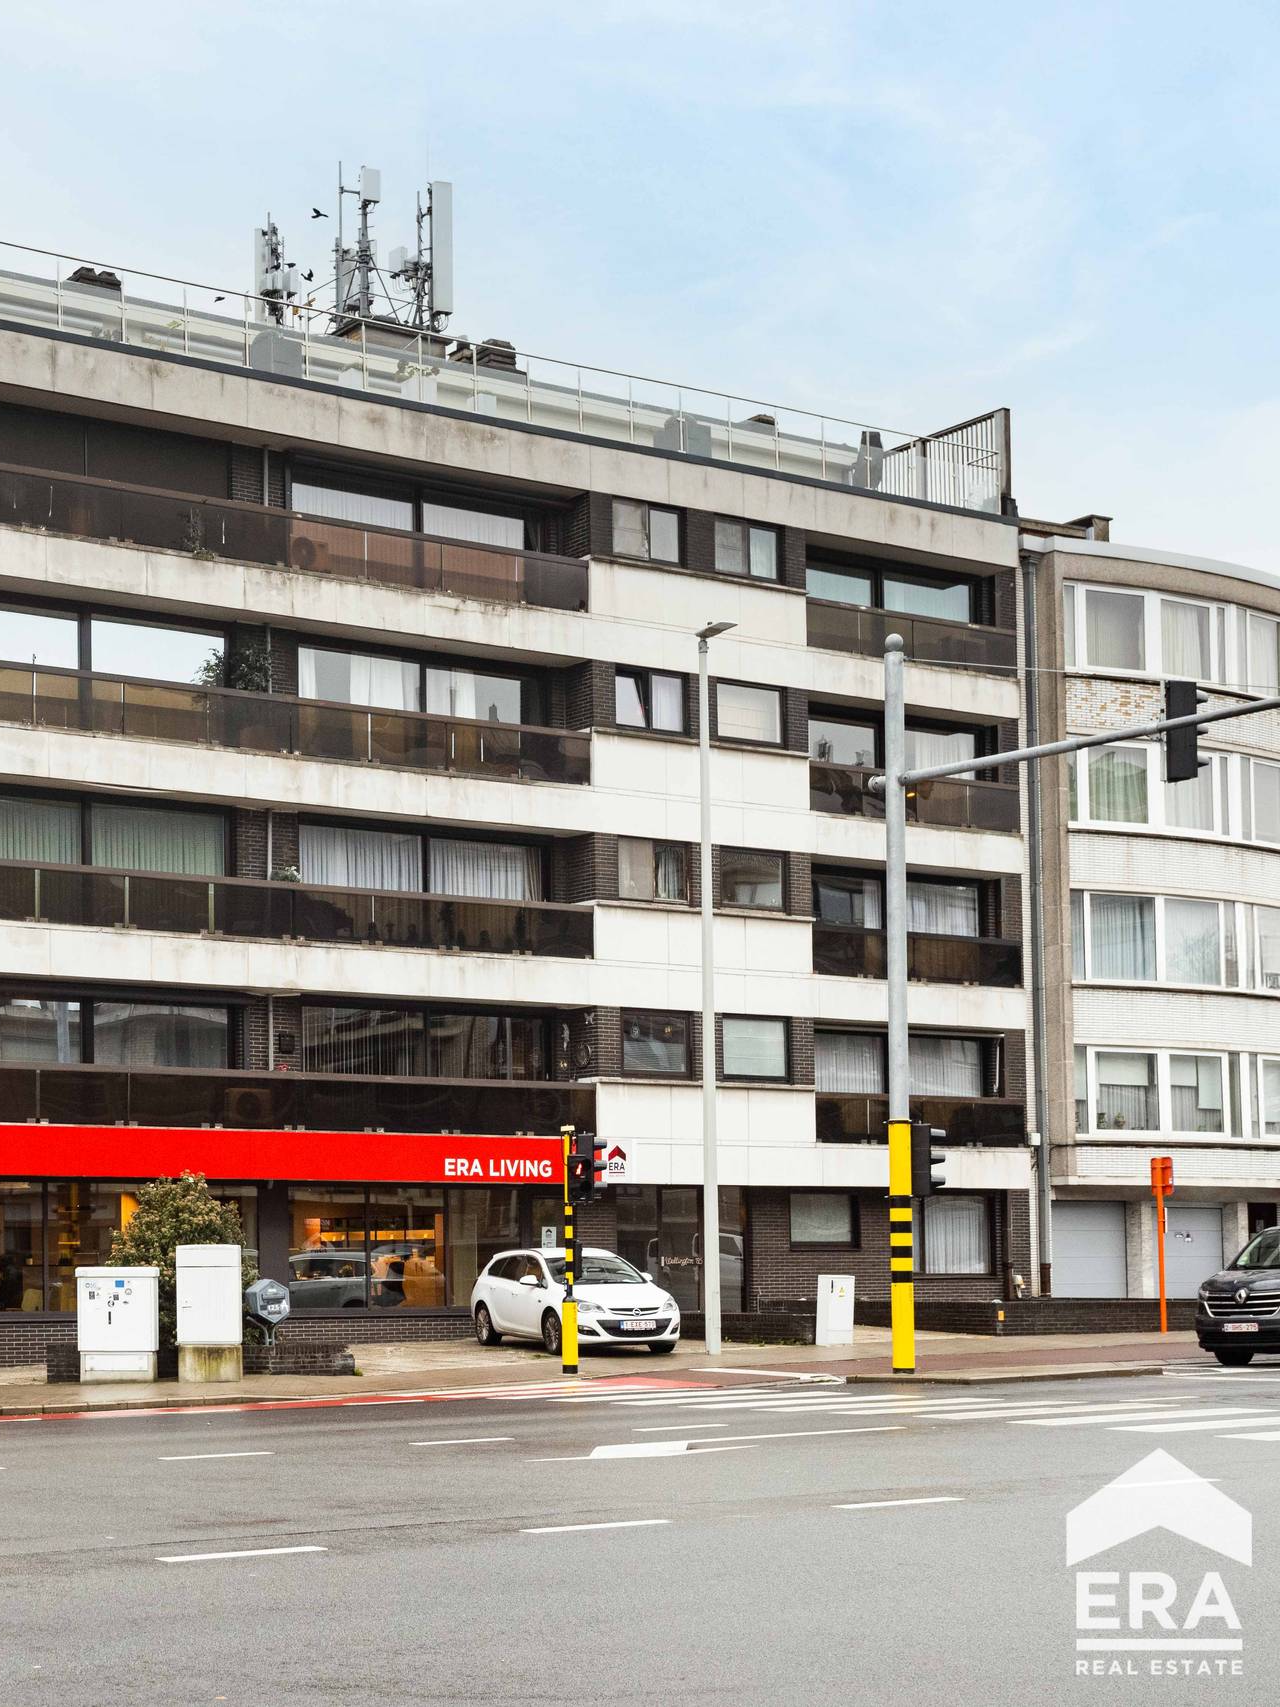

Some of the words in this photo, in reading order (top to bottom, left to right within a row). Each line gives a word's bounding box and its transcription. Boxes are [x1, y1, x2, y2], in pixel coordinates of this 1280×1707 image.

[444, 1158, 483, 1176] ERA
[489, 1159, 552, 1177] LIVING
[609, 1162, 625, 1171] ERA
[665, 1256, 694, 1266] Wellington
